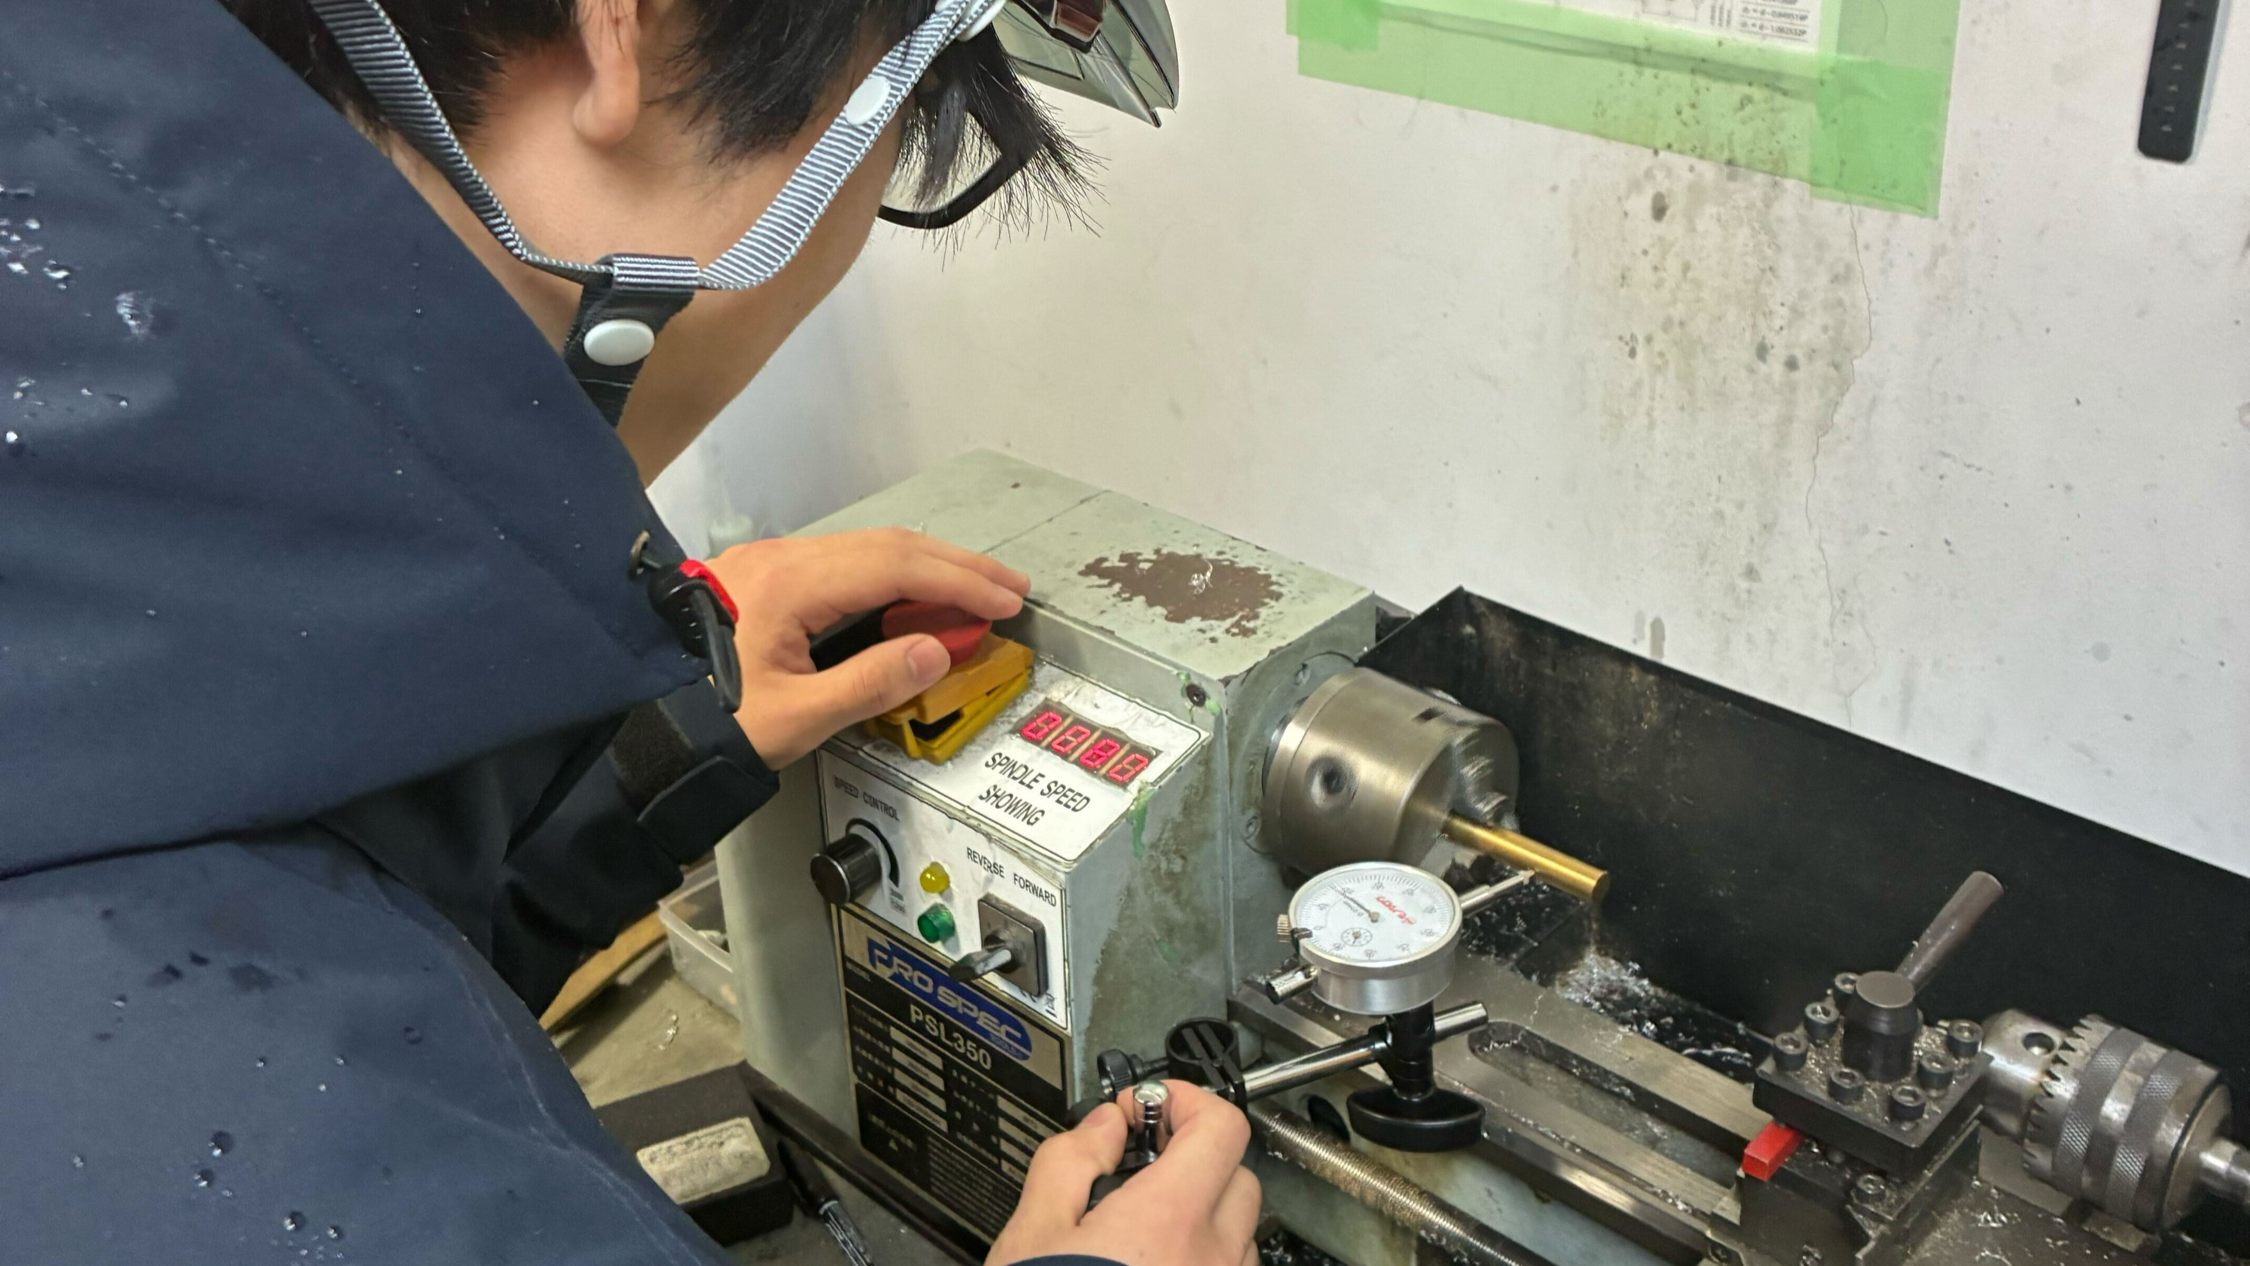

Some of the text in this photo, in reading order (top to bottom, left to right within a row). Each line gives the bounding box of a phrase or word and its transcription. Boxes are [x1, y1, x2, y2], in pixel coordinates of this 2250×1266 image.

[833, 776, 900, 822] SPEED CONTROL
[978, 784, 1046, 827] SHOWING
[984, 752, 1091, 813] SPINDLE SPEED
[966, 847, 1058, 908] REVERSE FORWARD
[874, 950, 934, 994] PRO
[937, 986, 1024, 1047] SPEC
[909, 1003, 993, 1071] PSL350
